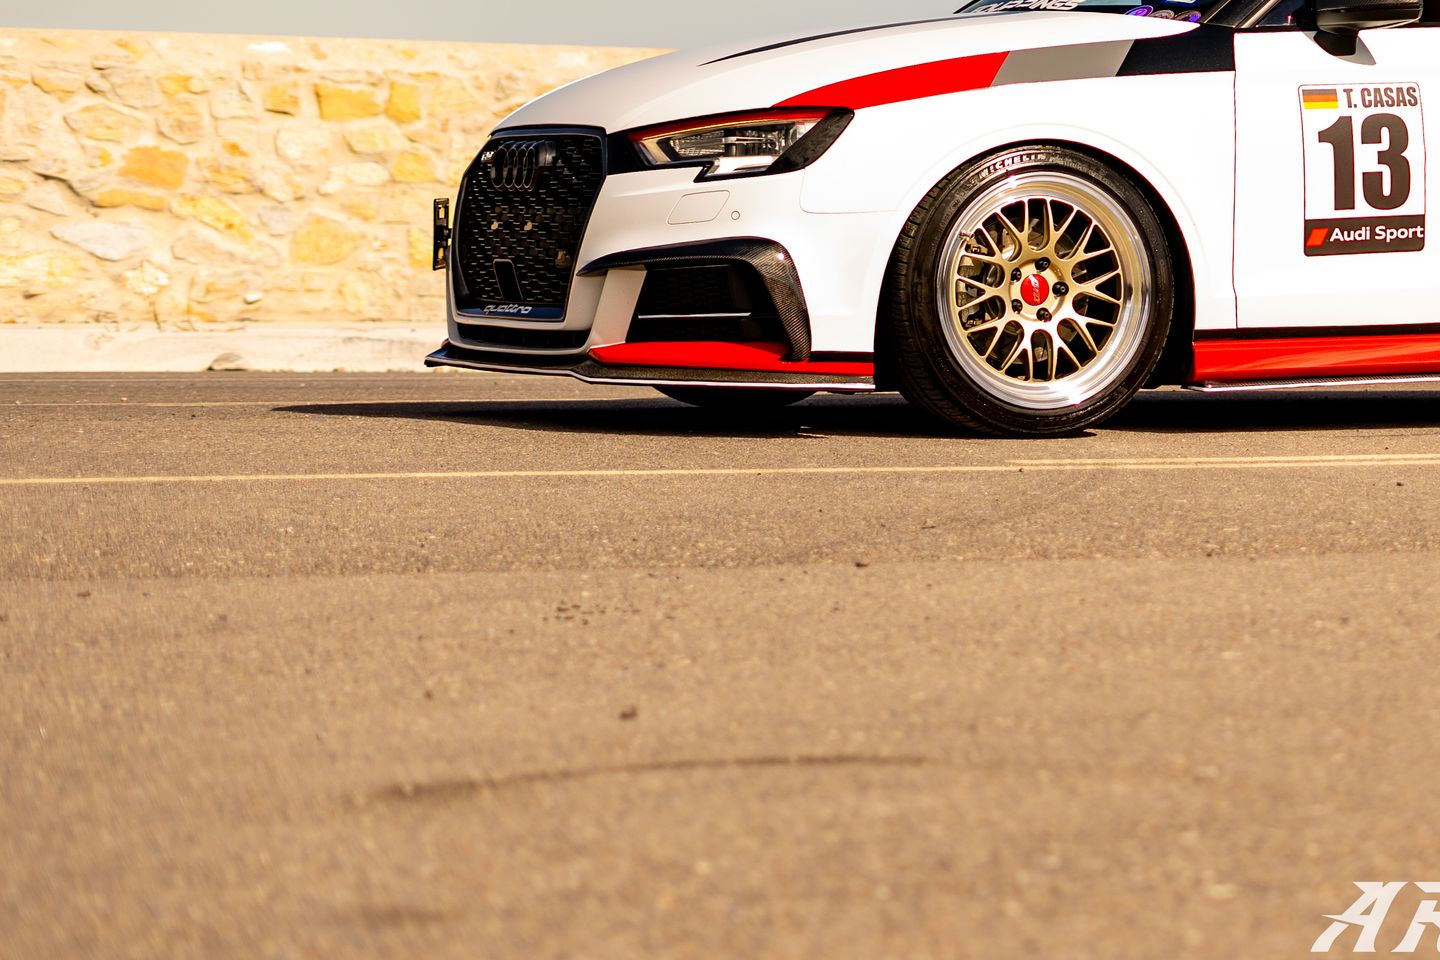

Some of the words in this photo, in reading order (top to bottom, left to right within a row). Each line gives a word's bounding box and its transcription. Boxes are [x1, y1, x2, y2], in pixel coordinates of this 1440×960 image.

[1342, 88, 1358, 109] T.
[1360, 86, 1419, 108] CASAS
[978, 153, 1047, 180] MICHELIN
[1317, 112, 1412, 211] 13
[1329, 226, 1371, 242] Audi
[1374, 225, 1425, 243] Sport
[483, 304, 533, 314] quattro
